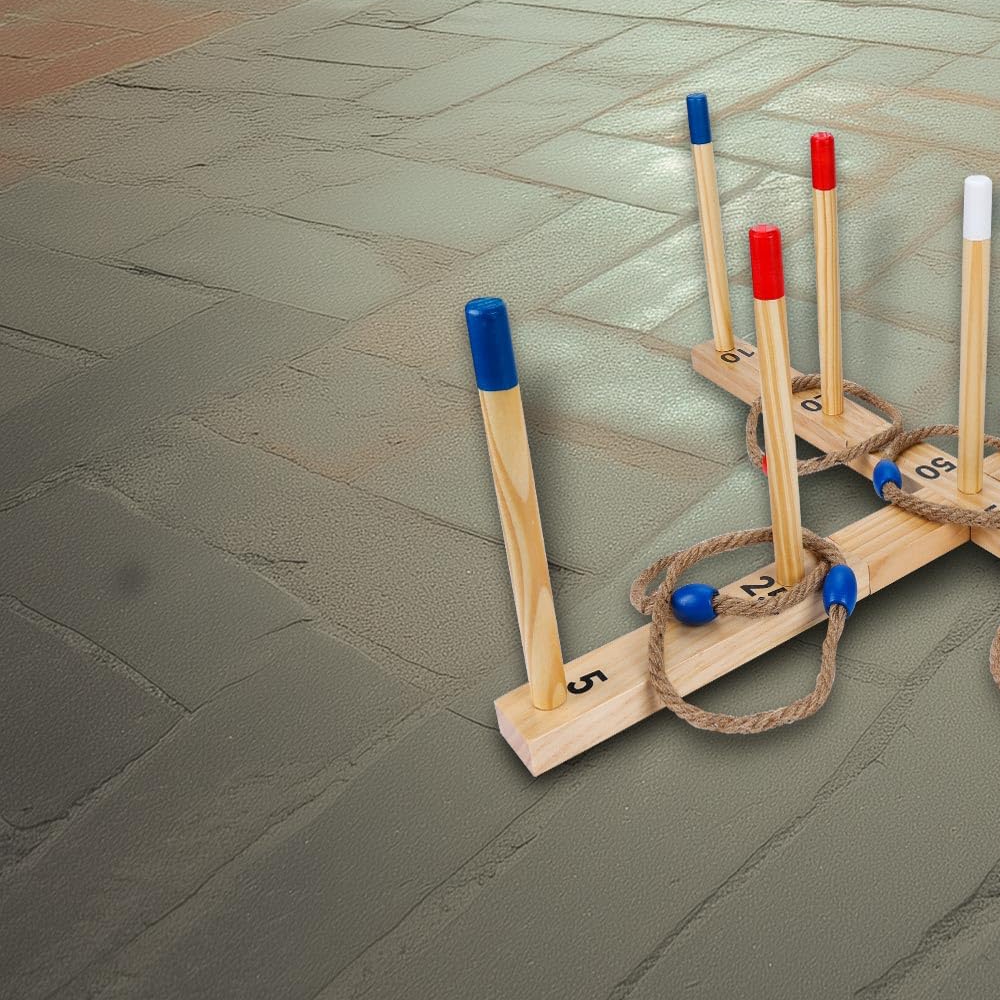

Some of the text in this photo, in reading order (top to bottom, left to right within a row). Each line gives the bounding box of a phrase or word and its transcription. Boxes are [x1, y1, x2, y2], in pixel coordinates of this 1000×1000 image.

[720, 348, 755, 363] 10
[800, 394, 822, 411] 0
[915, 457, 957, 480] 50
[567, 669, 608, 695] 5
